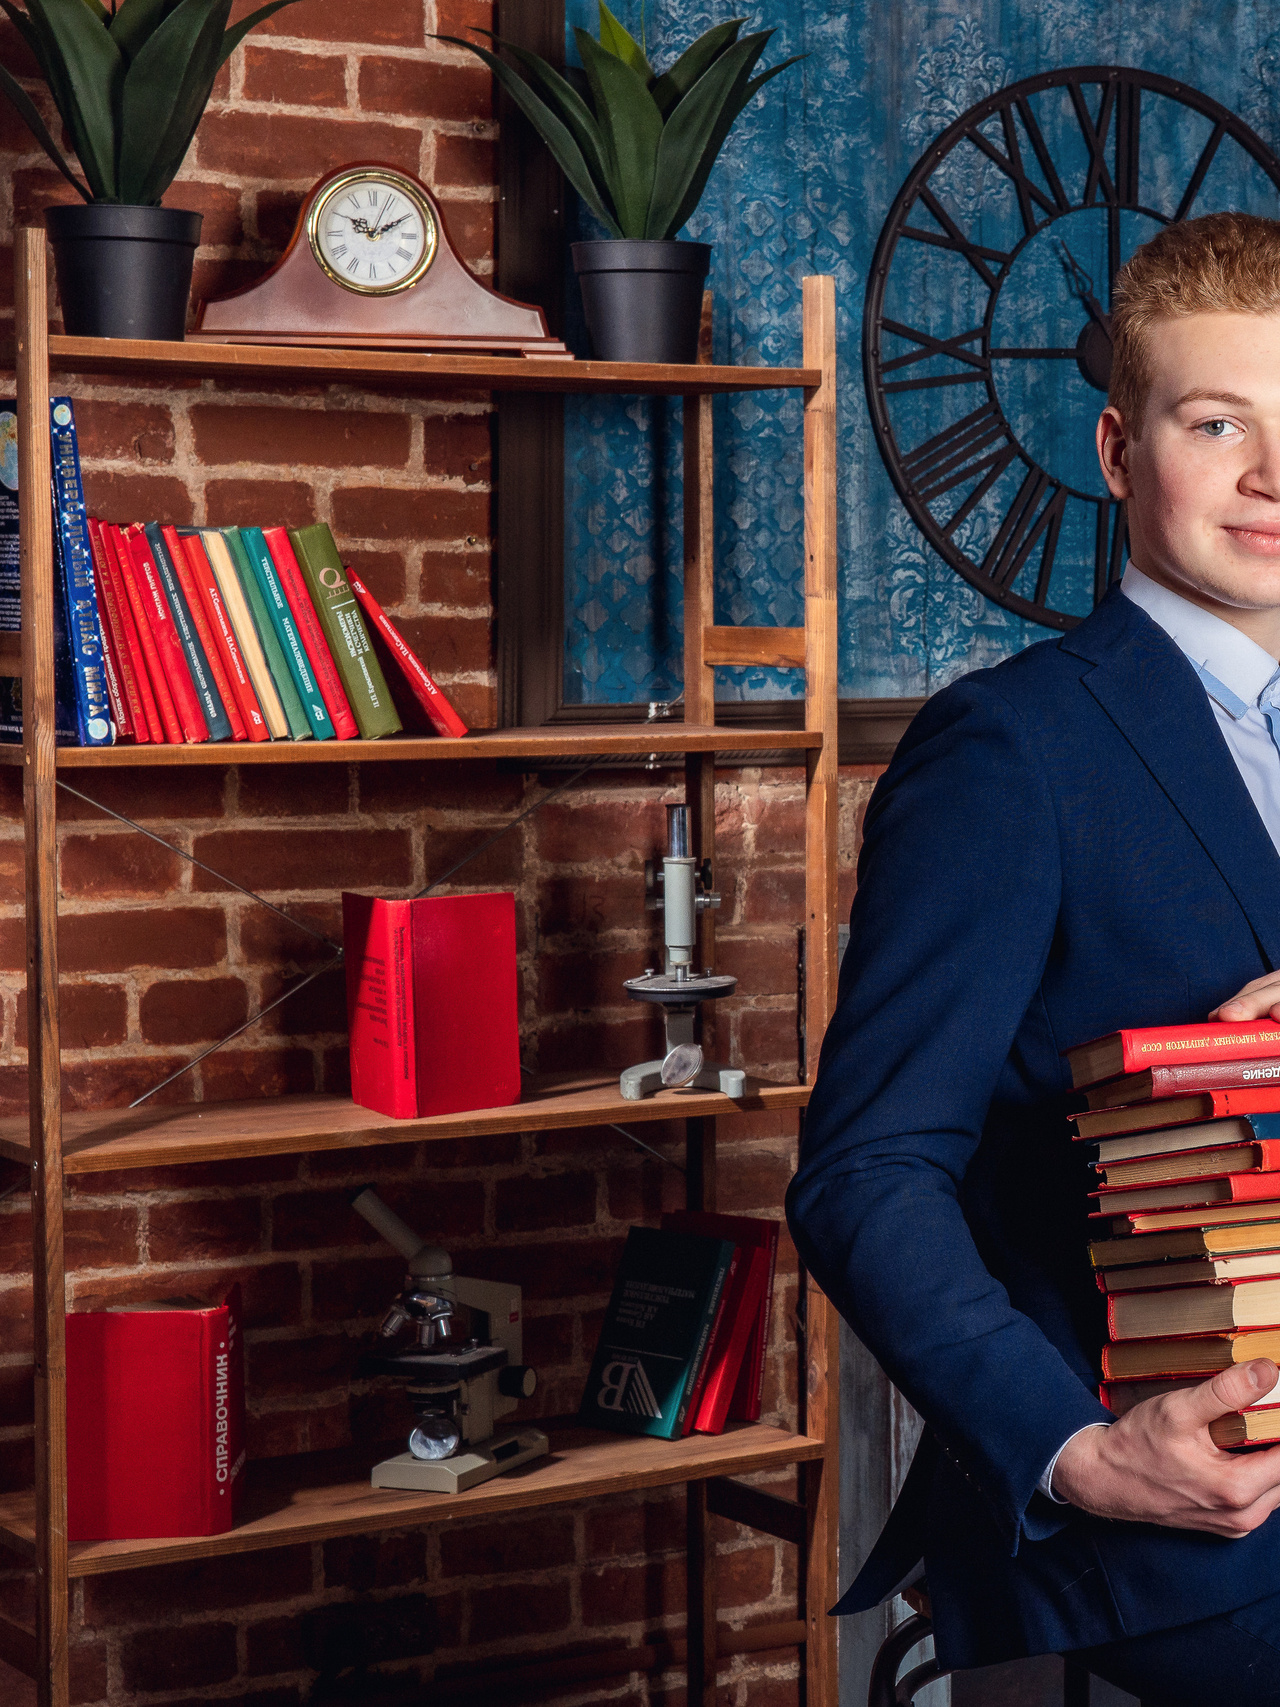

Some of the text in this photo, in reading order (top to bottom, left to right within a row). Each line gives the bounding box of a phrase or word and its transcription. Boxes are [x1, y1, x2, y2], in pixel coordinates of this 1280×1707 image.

[55, 432, 106, 718] УНИВЕРСАЛЬНЫЙ АТЛАС МИРА
[142, 561, 166, 619] МОНТАЖ ЛИФТОВ
[259, 556, 314, 694] ТЕКСТИЛЬНОЕ МАТЕРИАЛОВЕДЕНИЕ
[334, 609, 358, 657] РАСХОДОМЕРЫ
[343, 611, 362, 648] СЧЕТЧИКИ
[349, 608, 370, 652] КОЛИЧЕСТВА
[355, 655, 375, 693] Кремлевский
[114, 697, 125, 724] Монтаж
[203, 690, 217, 718] СМАЗКА
[1140, 1042, 1162, 1052] СССР
[1164, 1036, 1210, 1050] ДЕПУТАТОВ
[1212, 1032, 1256, 1045] НАРОДНЫХ
[216, 1353, 228, 1483] СПРАВОЧНИК
